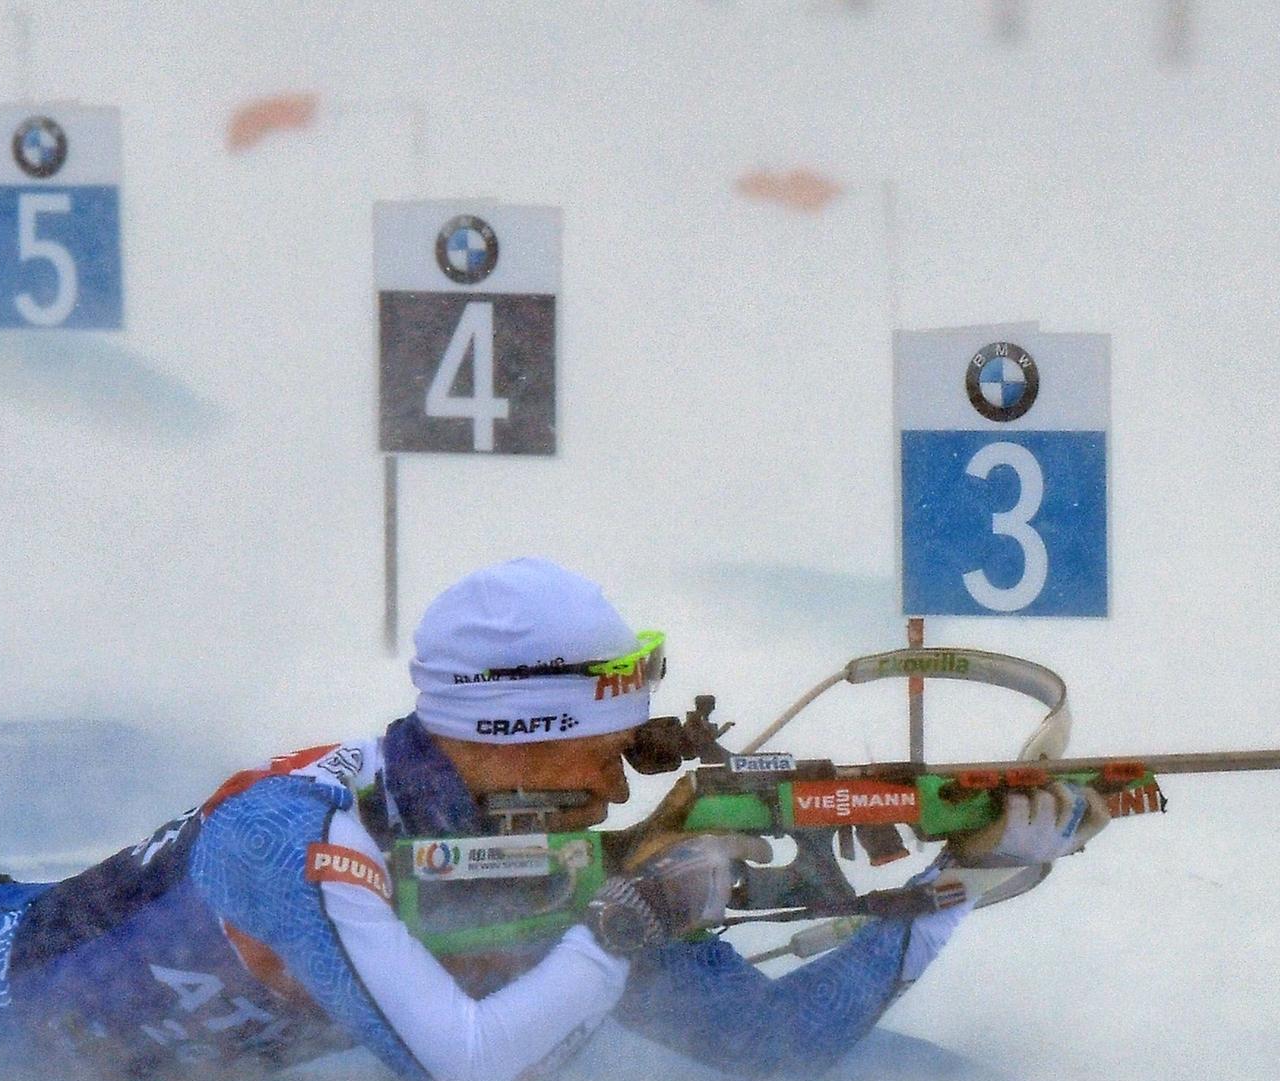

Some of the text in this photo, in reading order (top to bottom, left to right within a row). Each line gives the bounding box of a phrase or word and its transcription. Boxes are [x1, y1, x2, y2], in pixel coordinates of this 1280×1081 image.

[12, 193, 79, 327] 5
[972, 344, 1032, 369] BMW
[425, 301, 509, 450] 4
[962, 441, 1048, 612] 3
[476, 715, 558, 735] CRAFT
[734, 754, 790, 771] Patria
[797, 789, 915, 816] VIESSMANN
